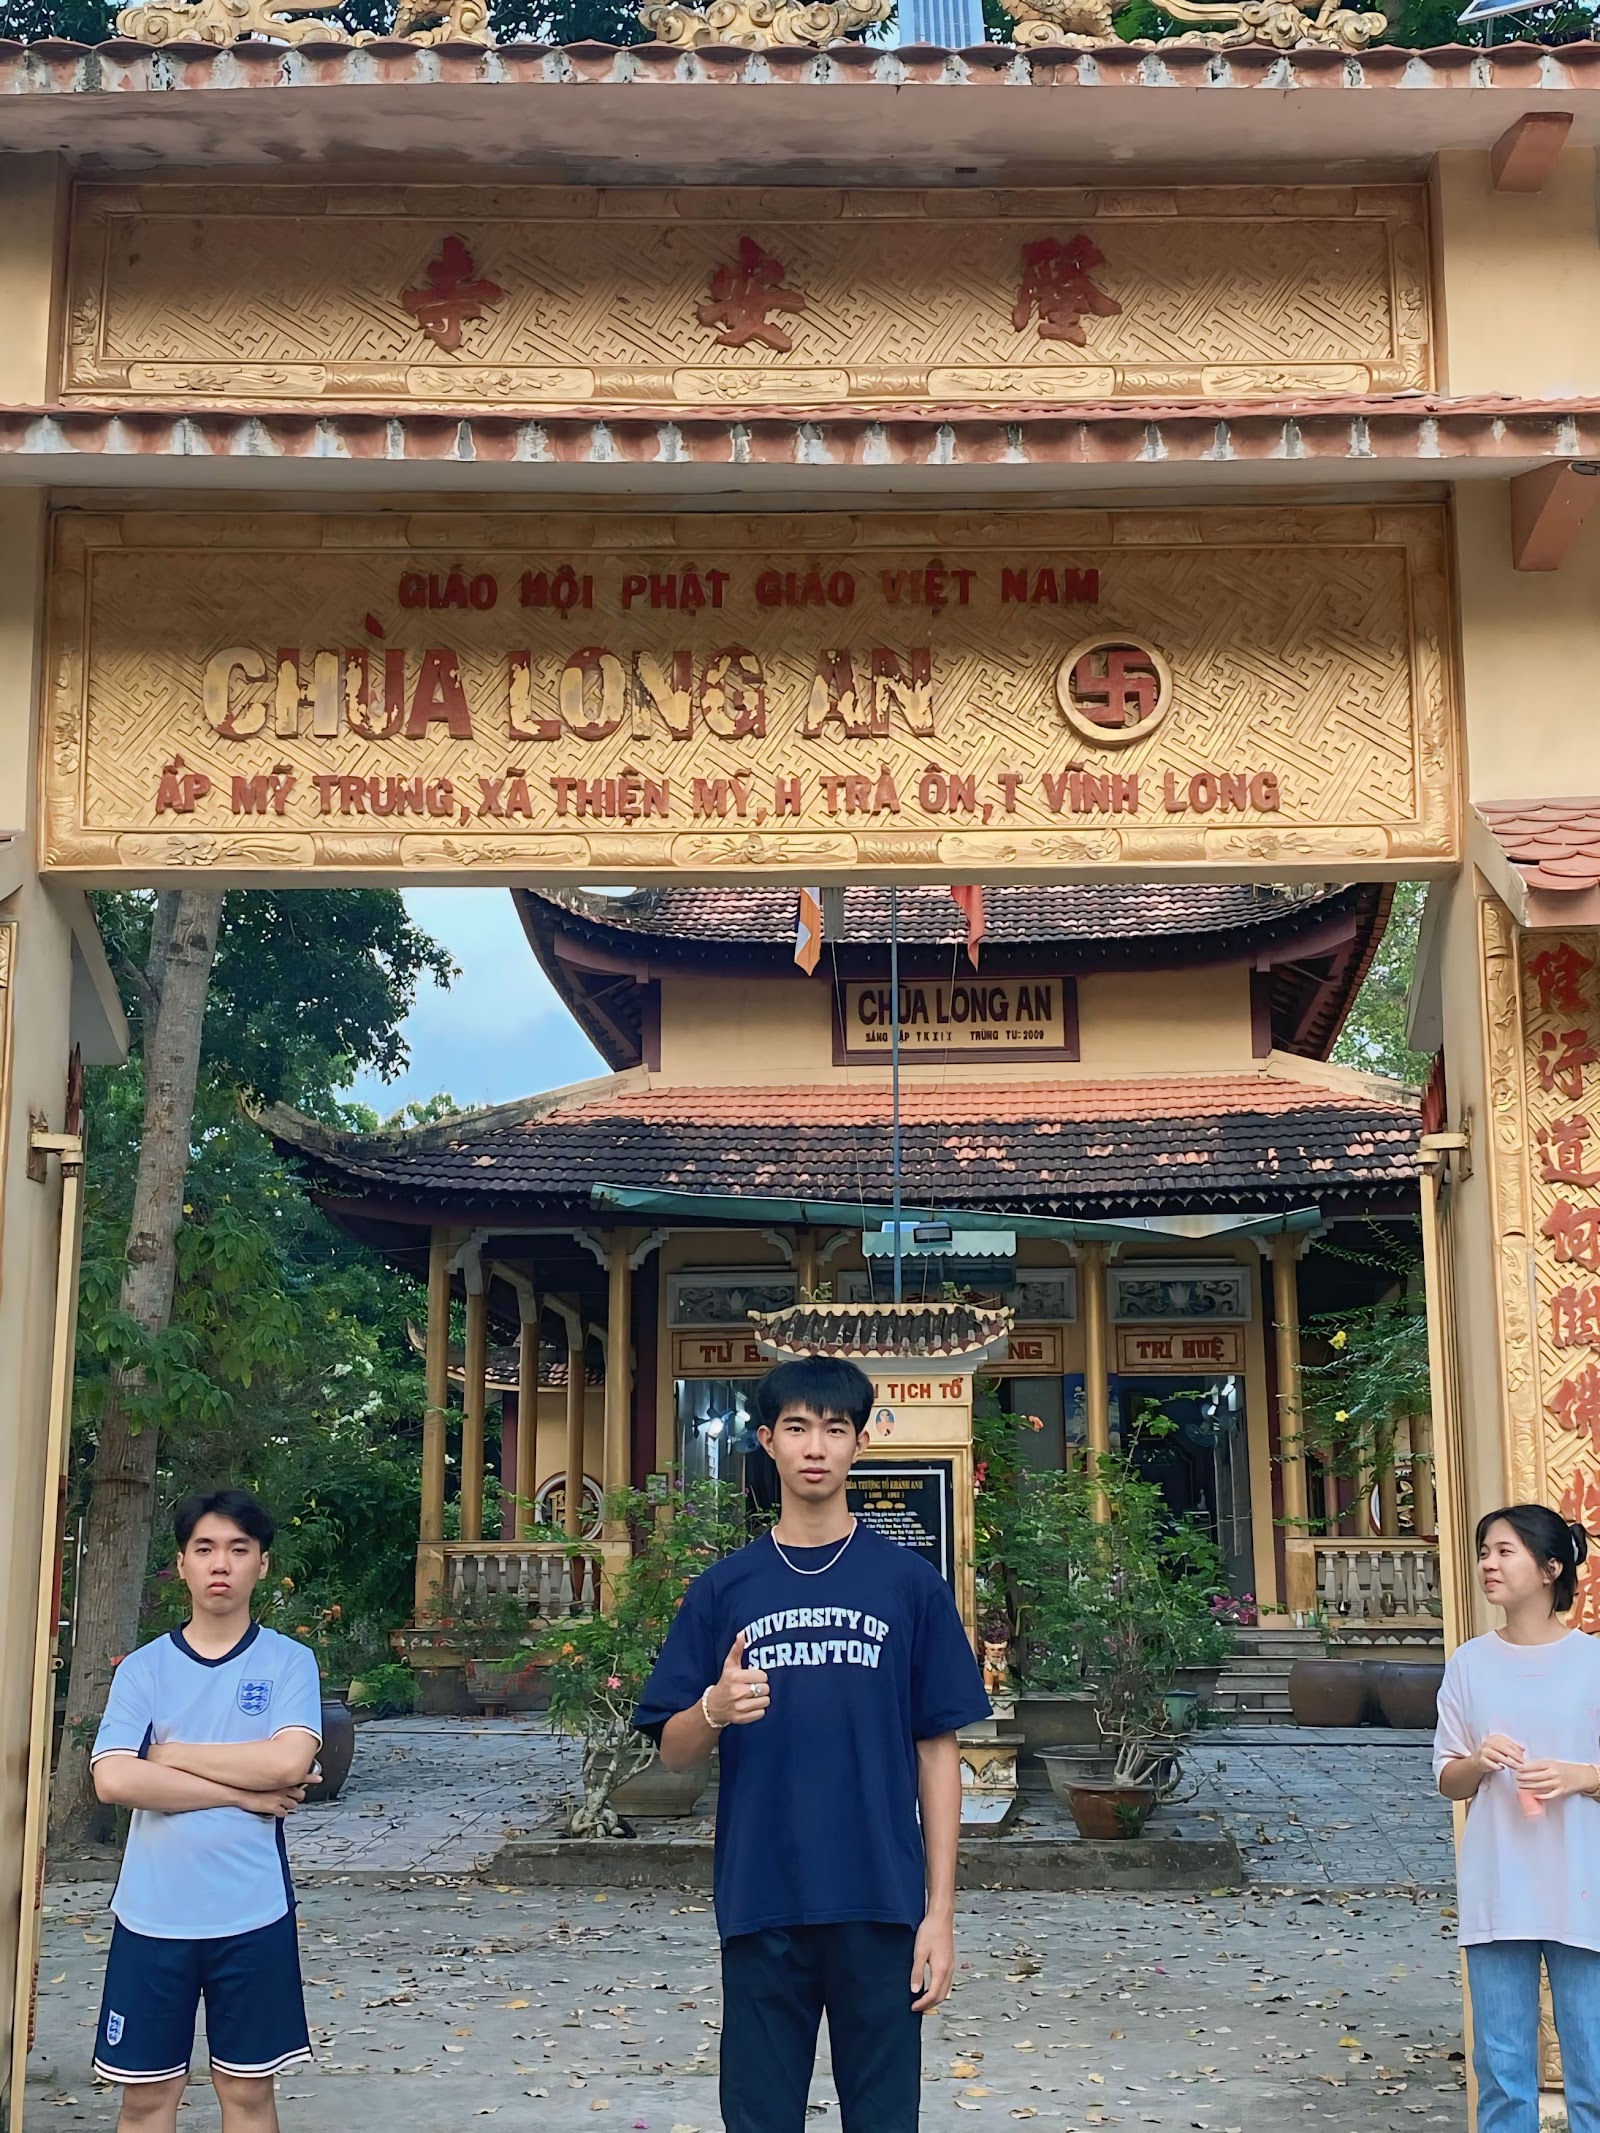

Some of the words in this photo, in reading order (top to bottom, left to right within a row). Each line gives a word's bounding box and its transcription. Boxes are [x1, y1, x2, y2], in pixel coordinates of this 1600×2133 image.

[399, 562, 498, 610] GIÁO
[519, 564, 594, 620] HỘI
[622, 561, 730, 616] PHẬT
[755, 562, 856, 608] GIÁO
[879, 558, 978, 617] VIỆT
[1001, 567, 1100, 607] NAM
[202, 611, 474, 742] CHÙA
[507, 645, 767, 742] LONG
[803, 646, 937, 740] AN
[155, 753, 212, 815] ẤP
[231, 763, 298, 815] MỸ
[550, 765, 670, 826] THIỆN
[819, 763, 901, 816] TRÀ
[1041, 761, 1139, 814] VĨNH
[1163, 770, 1281, 813] LONG
[936, 985, 1010, 1024] LONG
[1015, 985, 1053, 1022] AN
[1136, 1335, 1174, 1360] TRÍ
[887, 1383, 931, 1403] TỊCH
[744, 1607, 862, 1649] UNIVERSITY
[863, 1614, 890, 1642] OF
[748, 1639, 882, 1670] SCRANTON
